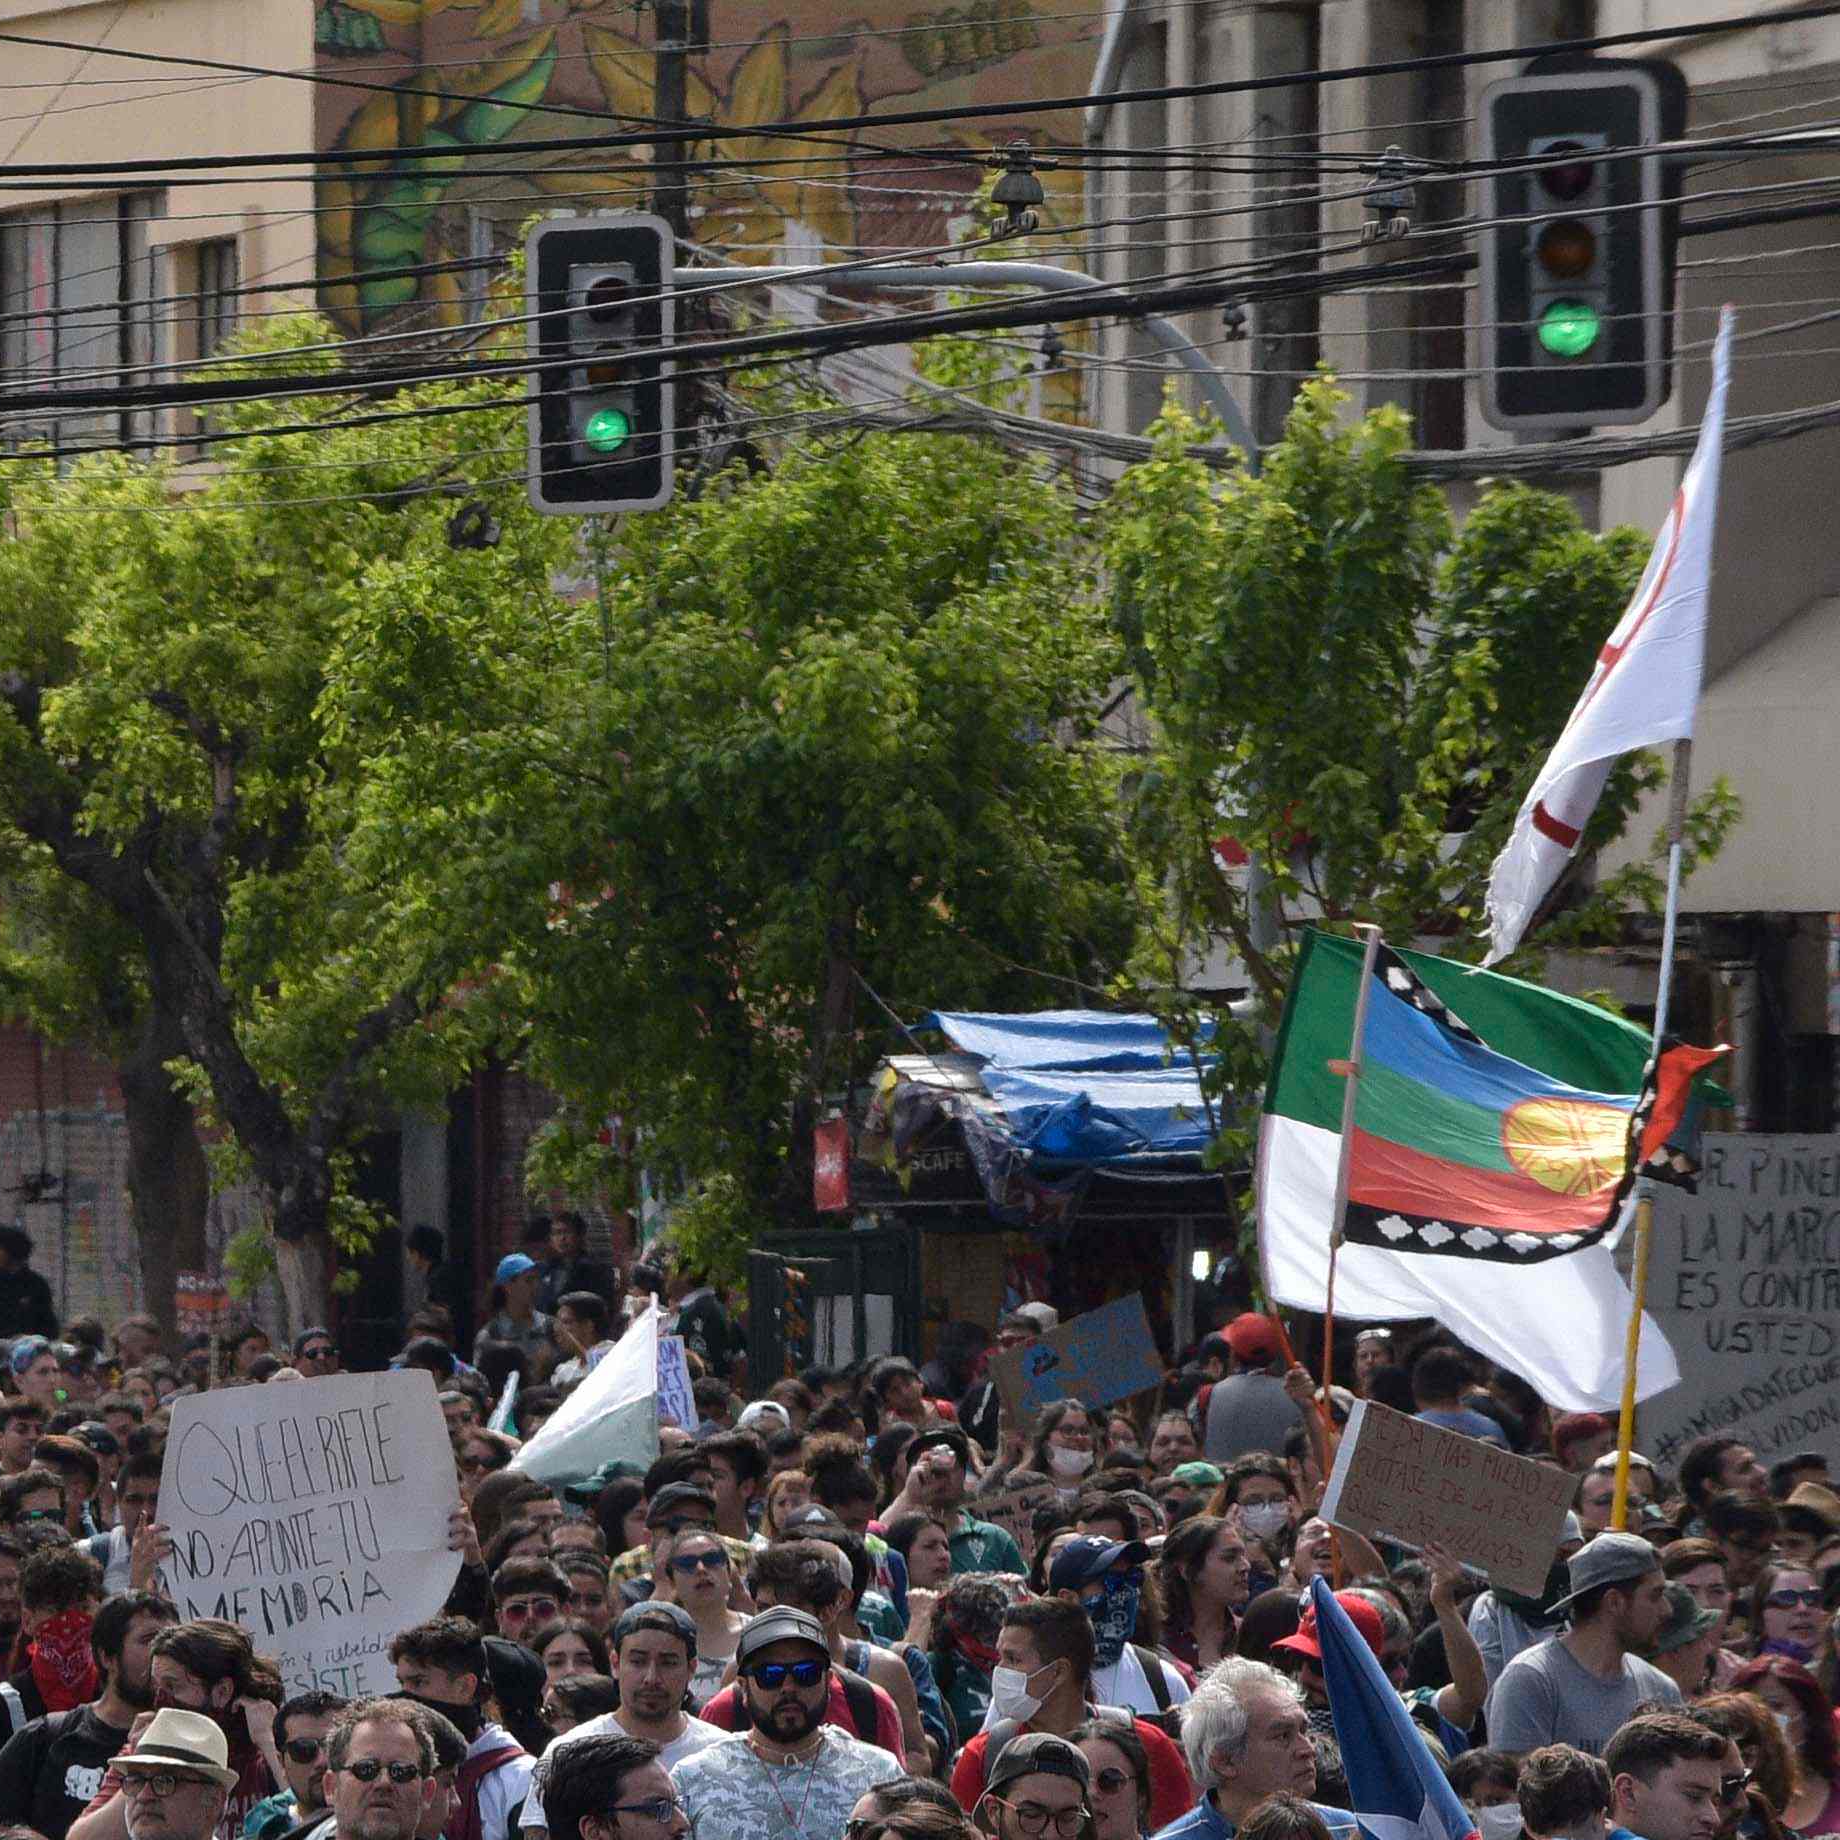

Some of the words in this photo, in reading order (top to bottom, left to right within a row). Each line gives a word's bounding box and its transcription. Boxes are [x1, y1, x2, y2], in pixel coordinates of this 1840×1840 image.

[1681, 1213, 1720, 1263] LA
[1676, 1271, 1720, 1311] ES
[1705, 1312, 1834, 1356] USTED
[171, 1529, 215, 1584] NO
[223, 1508, 332, 1577] APUNTE
[328, 1496, 381, 1565] TU
[186, 1571, 392, 1636] MEMORIA
